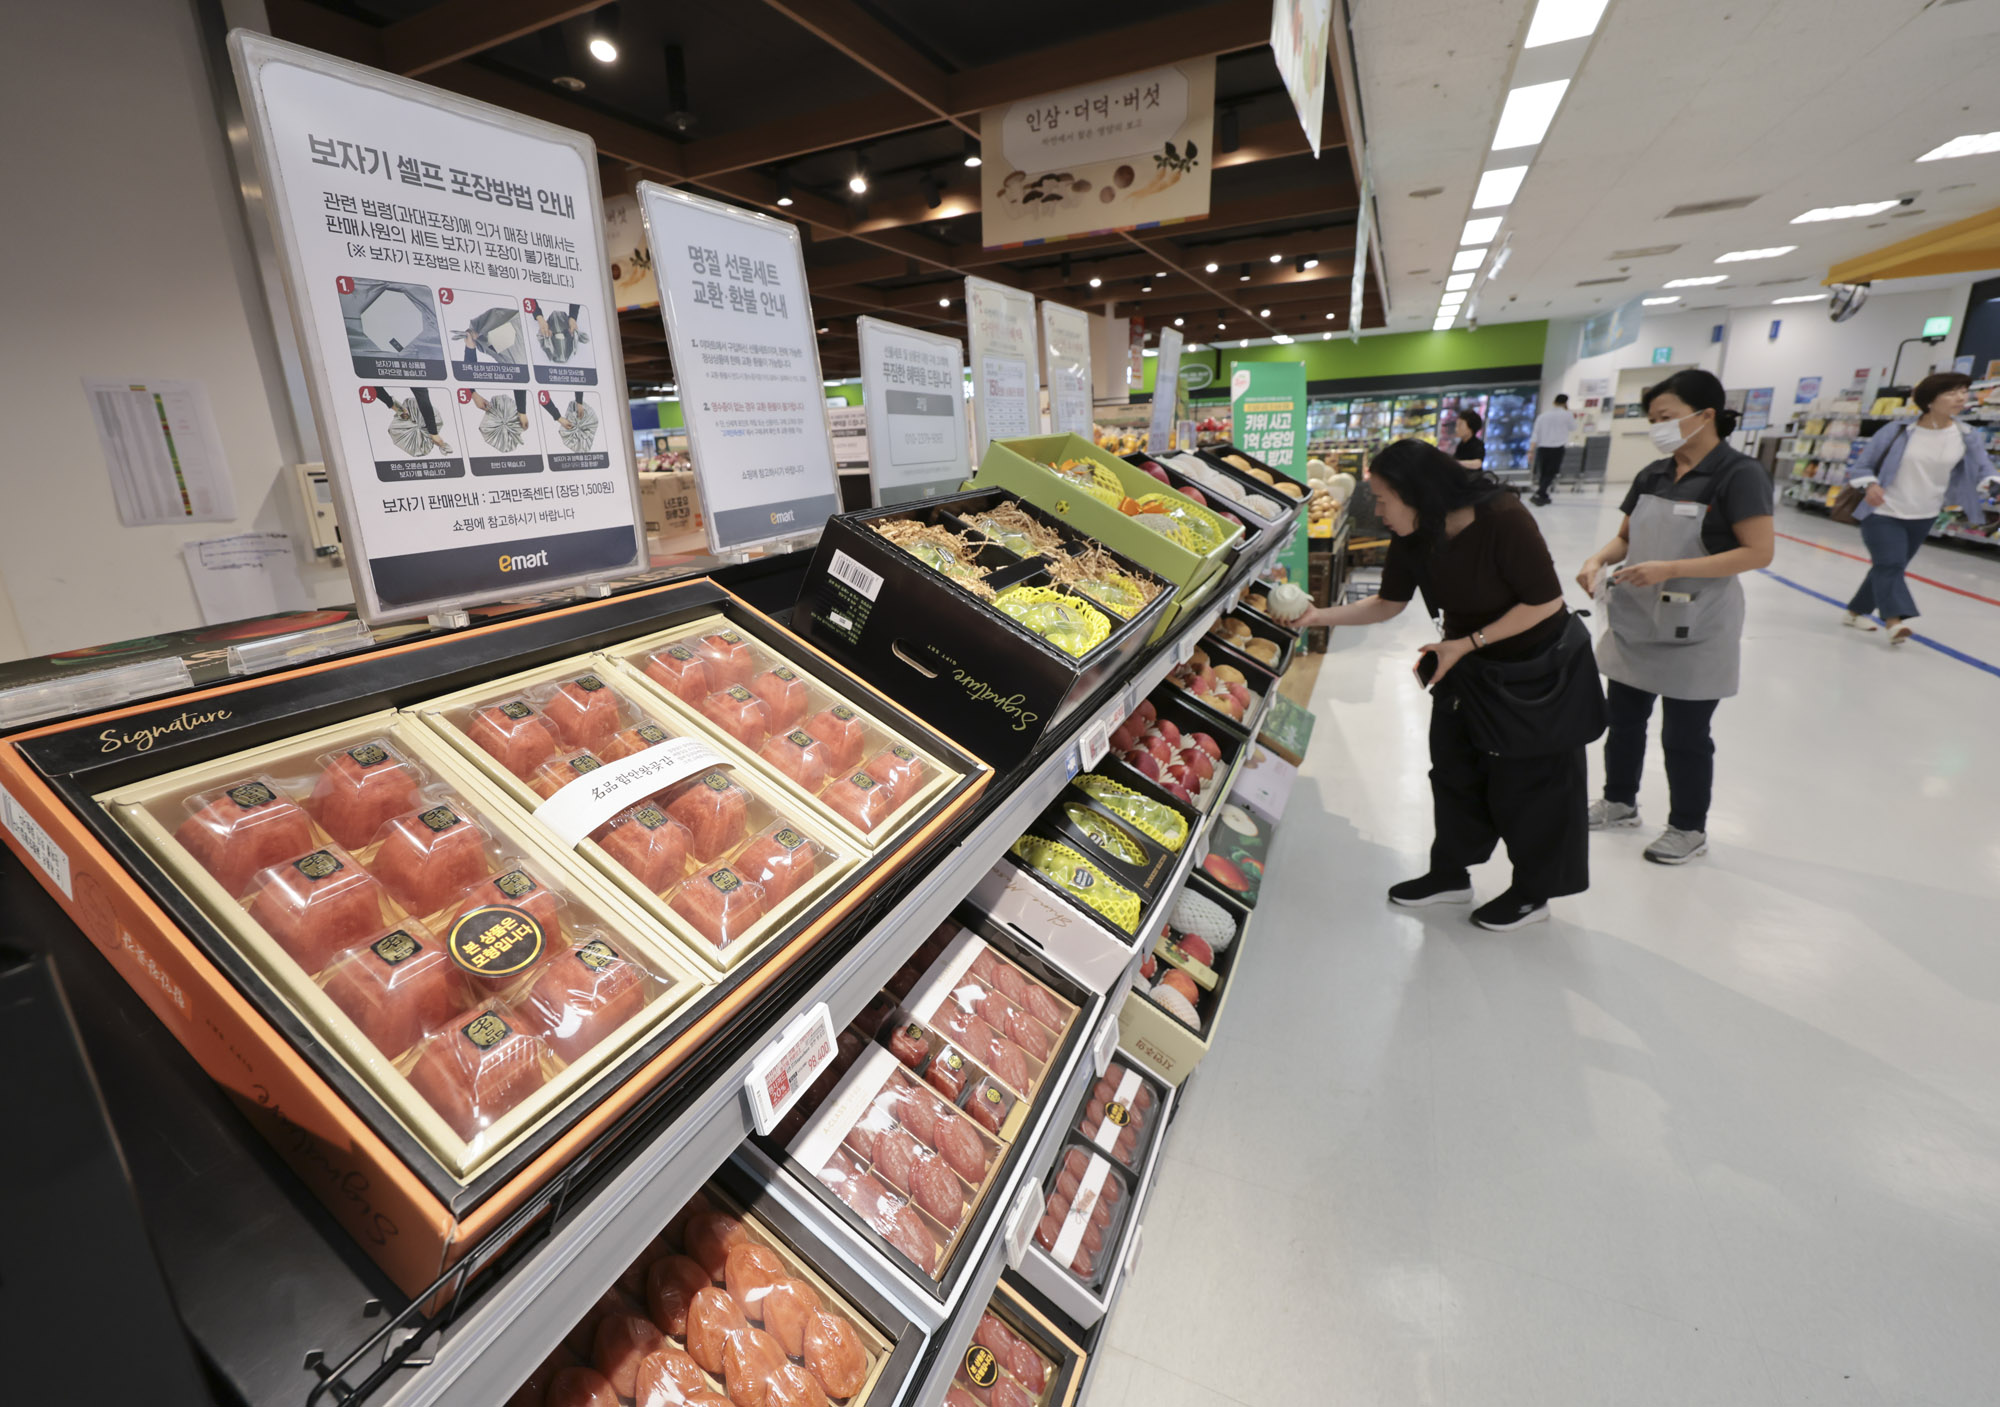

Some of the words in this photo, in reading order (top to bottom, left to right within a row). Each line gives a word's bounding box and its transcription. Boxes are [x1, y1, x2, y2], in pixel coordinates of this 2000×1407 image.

[308, 133, 392, 180] 보자기
[397, 155, 446, 191] 셀프
[449, 168, 534, 211] 포장방법
[537, 189, 575, 220] 안내
[323, 192, 358, 214] 관련
[475, 221, 501, 240] 의거
[503, 226, 528, 245] 매장
[531, 232, 576, 253] 내에서는
[325, 214, 407, 244] 판매사원의
[411, 228, 439, 248] 세트
[441, 234, 482, 256] 보자기
[484, 242, 522, 262] 포장이
[369, 245, 410, 265] 보자기
[412, 251, 461, 272] 포장법은
[464, 259, 486, 275] 사진
[487, 263, 520, 280] 촬영이
[687, 245, 722, 277] 명절
[725, 253, 781, 287] 선물세트
[760, 292, 789, 320] 안내
[382, 496, 425, 514] 보자기
[428, 492, 480, 511] 판매안내
[488, 485, 554, 505] 고객만족센터
[452, 515, 485, 533] 쇼핑에
[487, 512, 538, 530] 참고하시기
[539, 507, 576, 523] 바랍니다
[770, 509, 795, 525] emart
[498, 549, 549, 573] emart
[952, 669, 1038, 731] Signature
[99, 709, 233, 752] Signature
[591, 782, 619, 801] 名品
[615, 756, 675, 785] 함안왕곶감
[462, 941, 481, 956] 본
[479, 917, 518, 945] 상품은
[472, 924, 533, 968] 모형입니다
